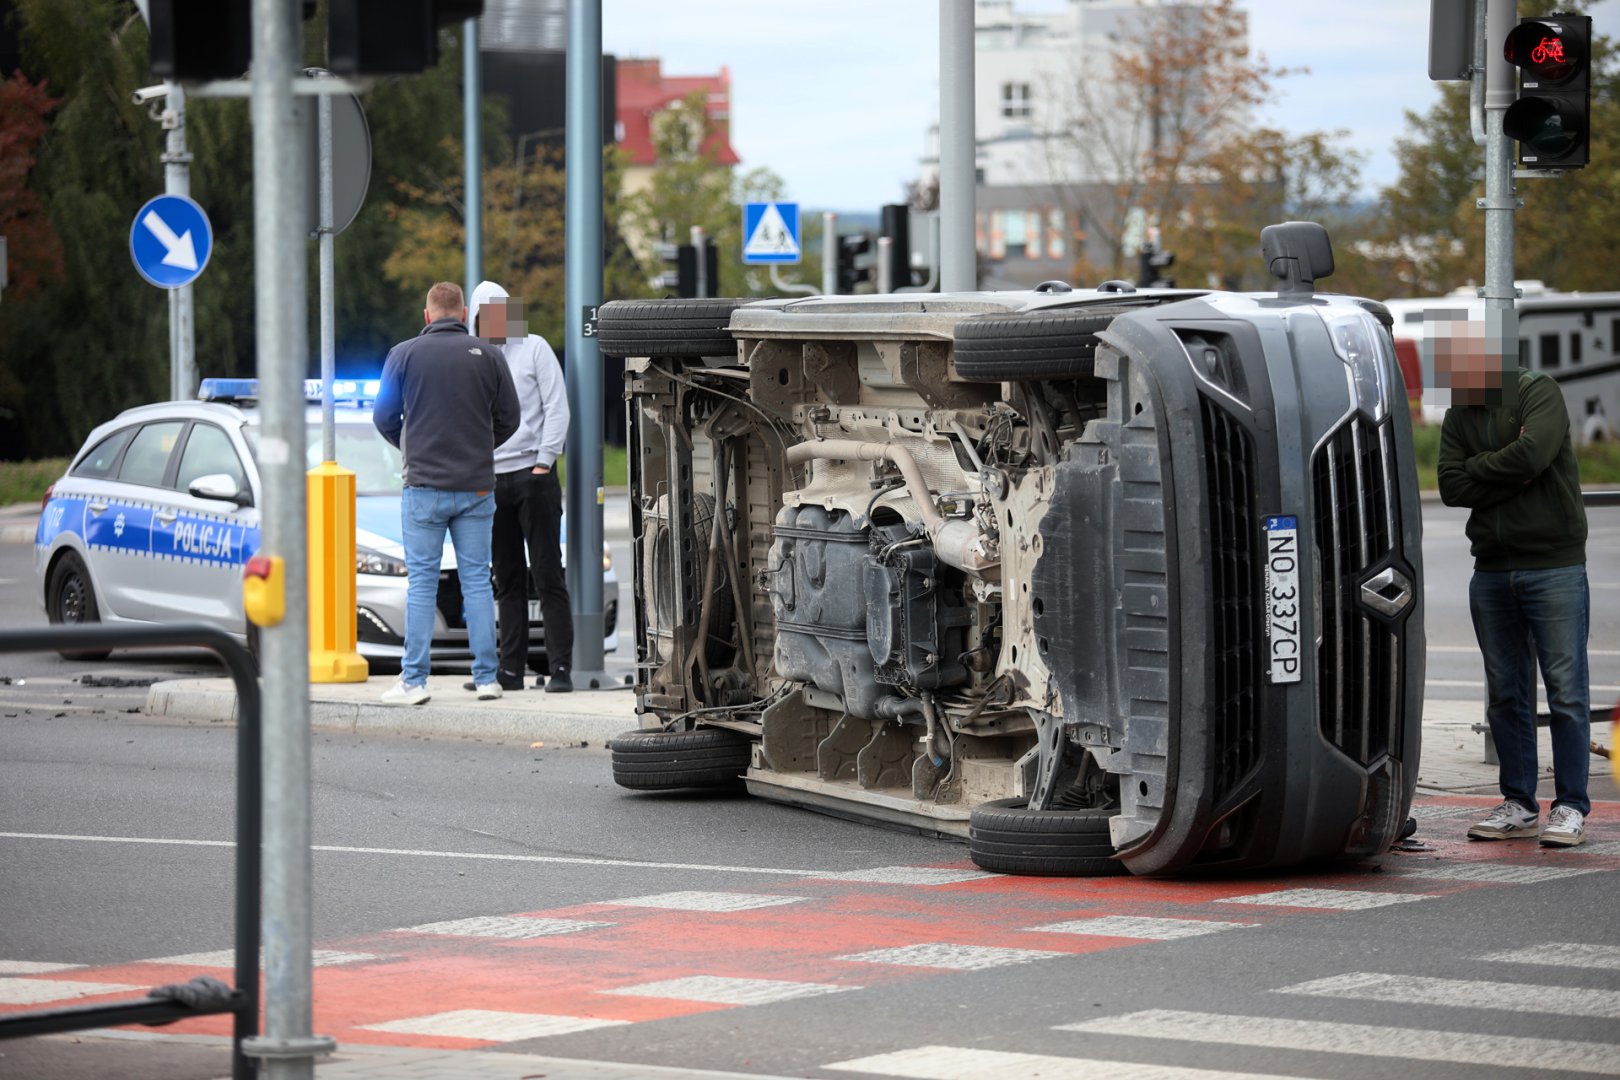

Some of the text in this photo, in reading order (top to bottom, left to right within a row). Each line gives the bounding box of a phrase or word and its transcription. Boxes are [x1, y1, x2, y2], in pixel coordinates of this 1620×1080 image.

[583, 322, 597, 336] 3-
[1270, 518, 1278, 530] PL
[173, 521, 232, 559] POLICJA
[1269, 536, 1297, 674] NO 337CP
